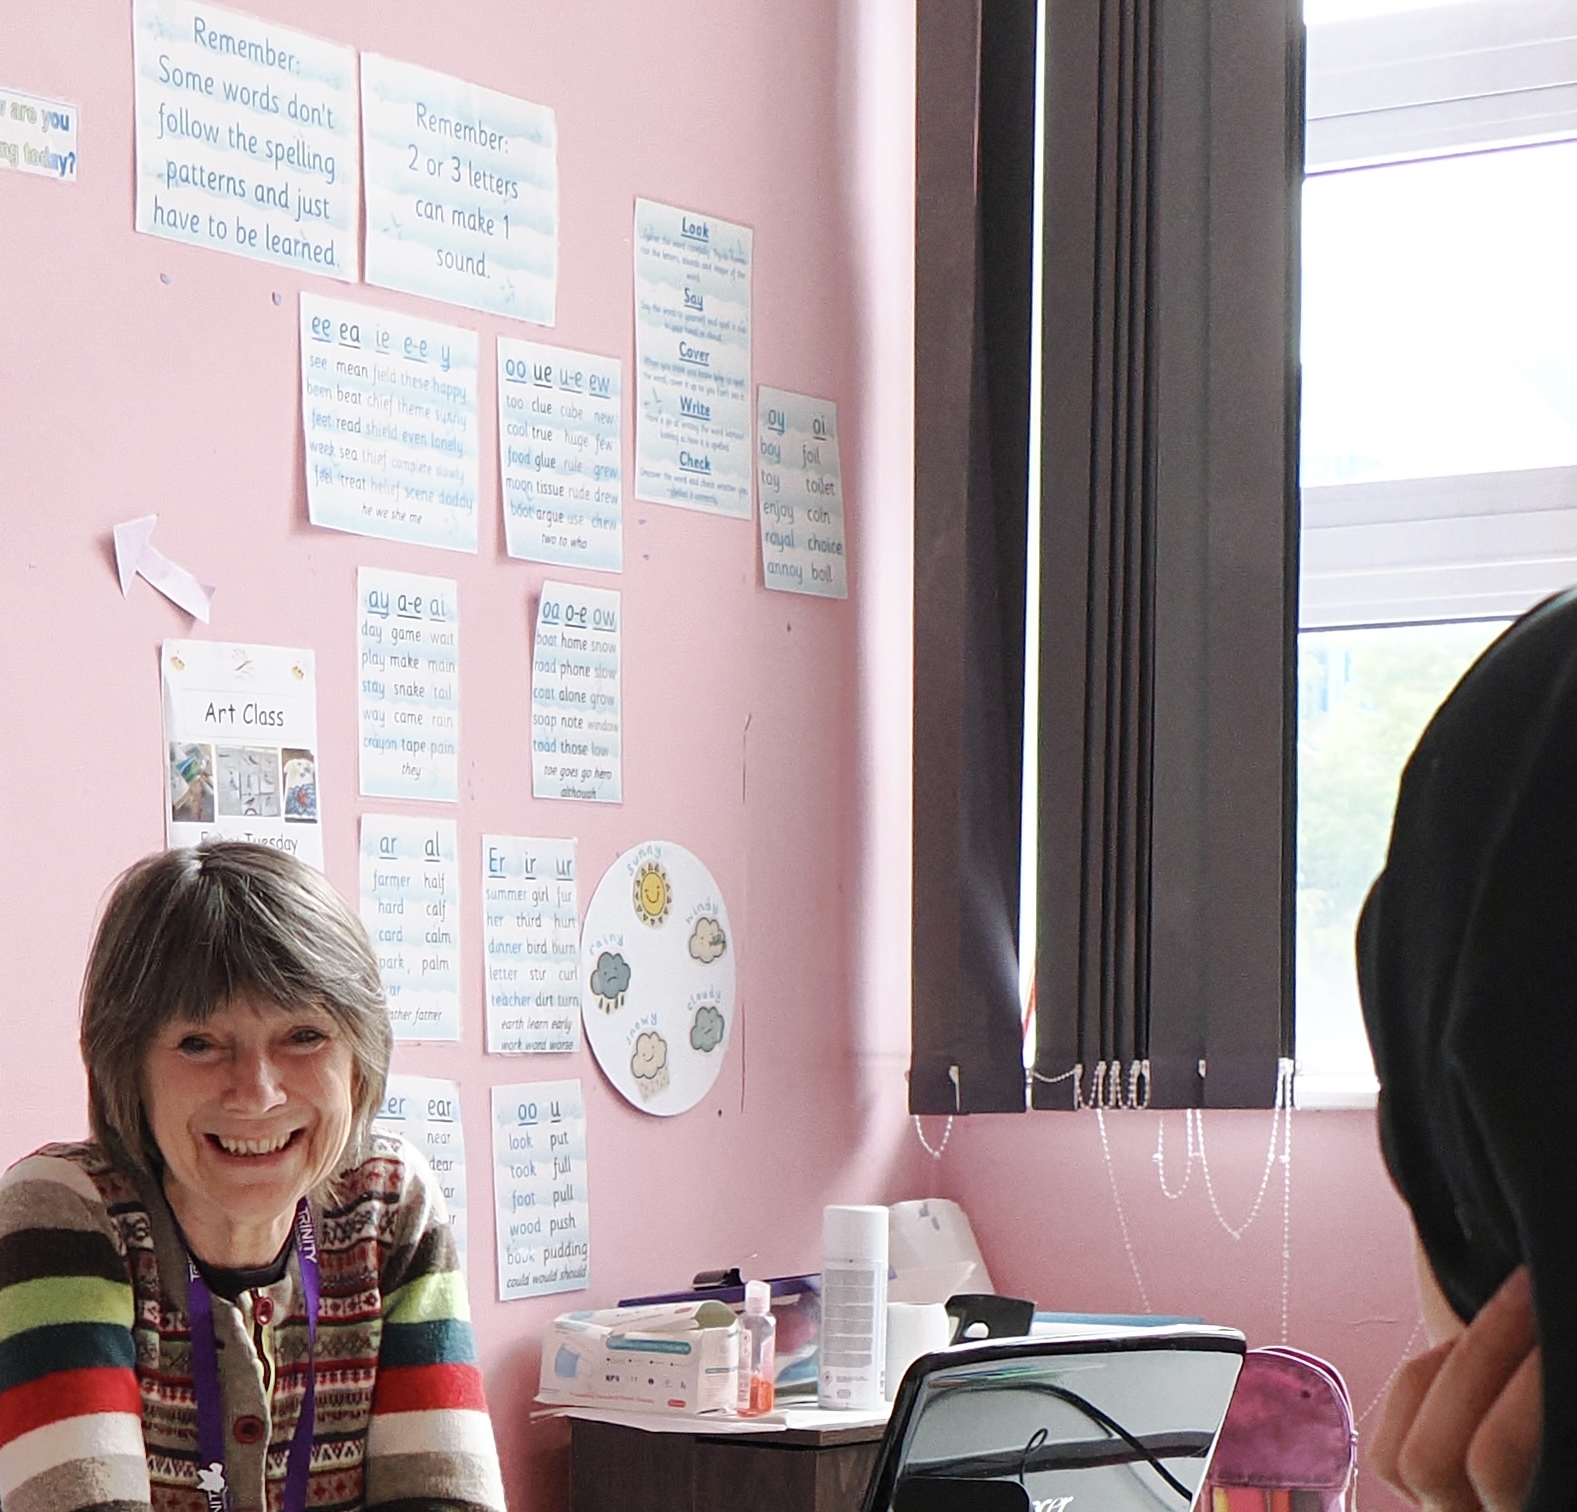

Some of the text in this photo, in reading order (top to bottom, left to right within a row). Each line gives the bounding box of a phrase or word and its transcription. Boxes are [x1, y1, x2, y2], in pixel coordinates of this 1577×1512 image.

[194, 16, 300, 75] Remember:
[158, 55, 334, 129] Some words don't
[10, 102, 37, 124] are
[41, 110, 70, 133] you
[416, 102, 509, 154] Remember:
[157, 102, 336, 184] follow the spelling
[23, 142, 76, 177] today?
[407, 144, 518, 200] 2 or 3 letters
[166, 159, 329, 222] patterns and just
[416, 199, 510, 240] can make 1
[682, 216, 709, 238] Look
[154, 196, 341, 269] have to be learned.
[436, 249, 491, 279] sound.
[684, 288, 703, 311] Say
[312, 316, 450, 371] ee ea ie e-e y
[679, 340, 710, 364] Cover
[336, 360, 466, 404] mean field these happy
[506, 359, 611, 394] oo ue u-e ew
[337, 385, 362, 405] beat
[680, 395, 710, 417] Write
[532, 396, 583, 420] clue cube
[768, 410, 785, 436] oy
[813, 416, 826, 435] oi
[336, 416, 464, 458] read shield lonely
[532, 426, 589, 448] true huge
[679, 450, 711, 472] Check
[760, 436, 821, 469] boy foil
[535, 450, 618, 481] glue grew
[340, 470, 366, 489] treat
[806, 478, 835, 496] toilet
[536, 479, 618, 505] tissue drew
[536, 509, 564, 528] argue
[764, 502, 831, 524] enjoy coin
[765, 529, 843, 556] royal choice
[767, 561, 832, 585] annoy boil
[368, 590, 446, 619] ay a-e ai
[543, 602, 616, 627] oa o-e ow
[361, 619, 454, 646] day game wait
[561, 632, 588, 651] home
[362, 650, 419, 672] play make
[560, 660, 590, 680] phone
[362, 680, 425, 700] stay snake
[559, 689, 586, 704] alone
[205, 702, 284, 727] Art Class
[394, 711, 423, 725] came
[561, 716, 583, 729] note
[401, 738, 426, 758] tape
[402, 763, 422, 781] they
[380, 831, 440, 857] ar al
[489, 848, 506, 873] Er
[556, 857, 572, 876] ur
[626, 845, 662, 877] sunny
[373, 869, 445, 895] farmer half
[532, 887, 550, 907] girl
[378, 899, 447, 922] hard calf
[517, 913, 542, 928] third
[686, 897, 719, 925] windy
[379, 926, 451, 944] card calm
[488, 938, 547, 954] dinner bird
[589, 933, 625, 956] rainy
[379, 953, 449, 976] park palm
[535, 993, 553, 1007] dirt
[686, 985, 722, 1011] cloudy
[626, 1011, 659, 1046] snowy
[427, 1099, 451, 1117] ear
[518, 1100, 560, 1120] oo u
[427, 1132, 450, 1144] near
[509, 1132, 569, 1150] look put
[511, 1158, 571, 1180] took full
[512, 1184, 573, 1214] foot pull
[297, 1208, 319, 1264] TRINITY
[510, 1213, 576, 1236] wood push
[544, 1242, 587, 1266] pudding
